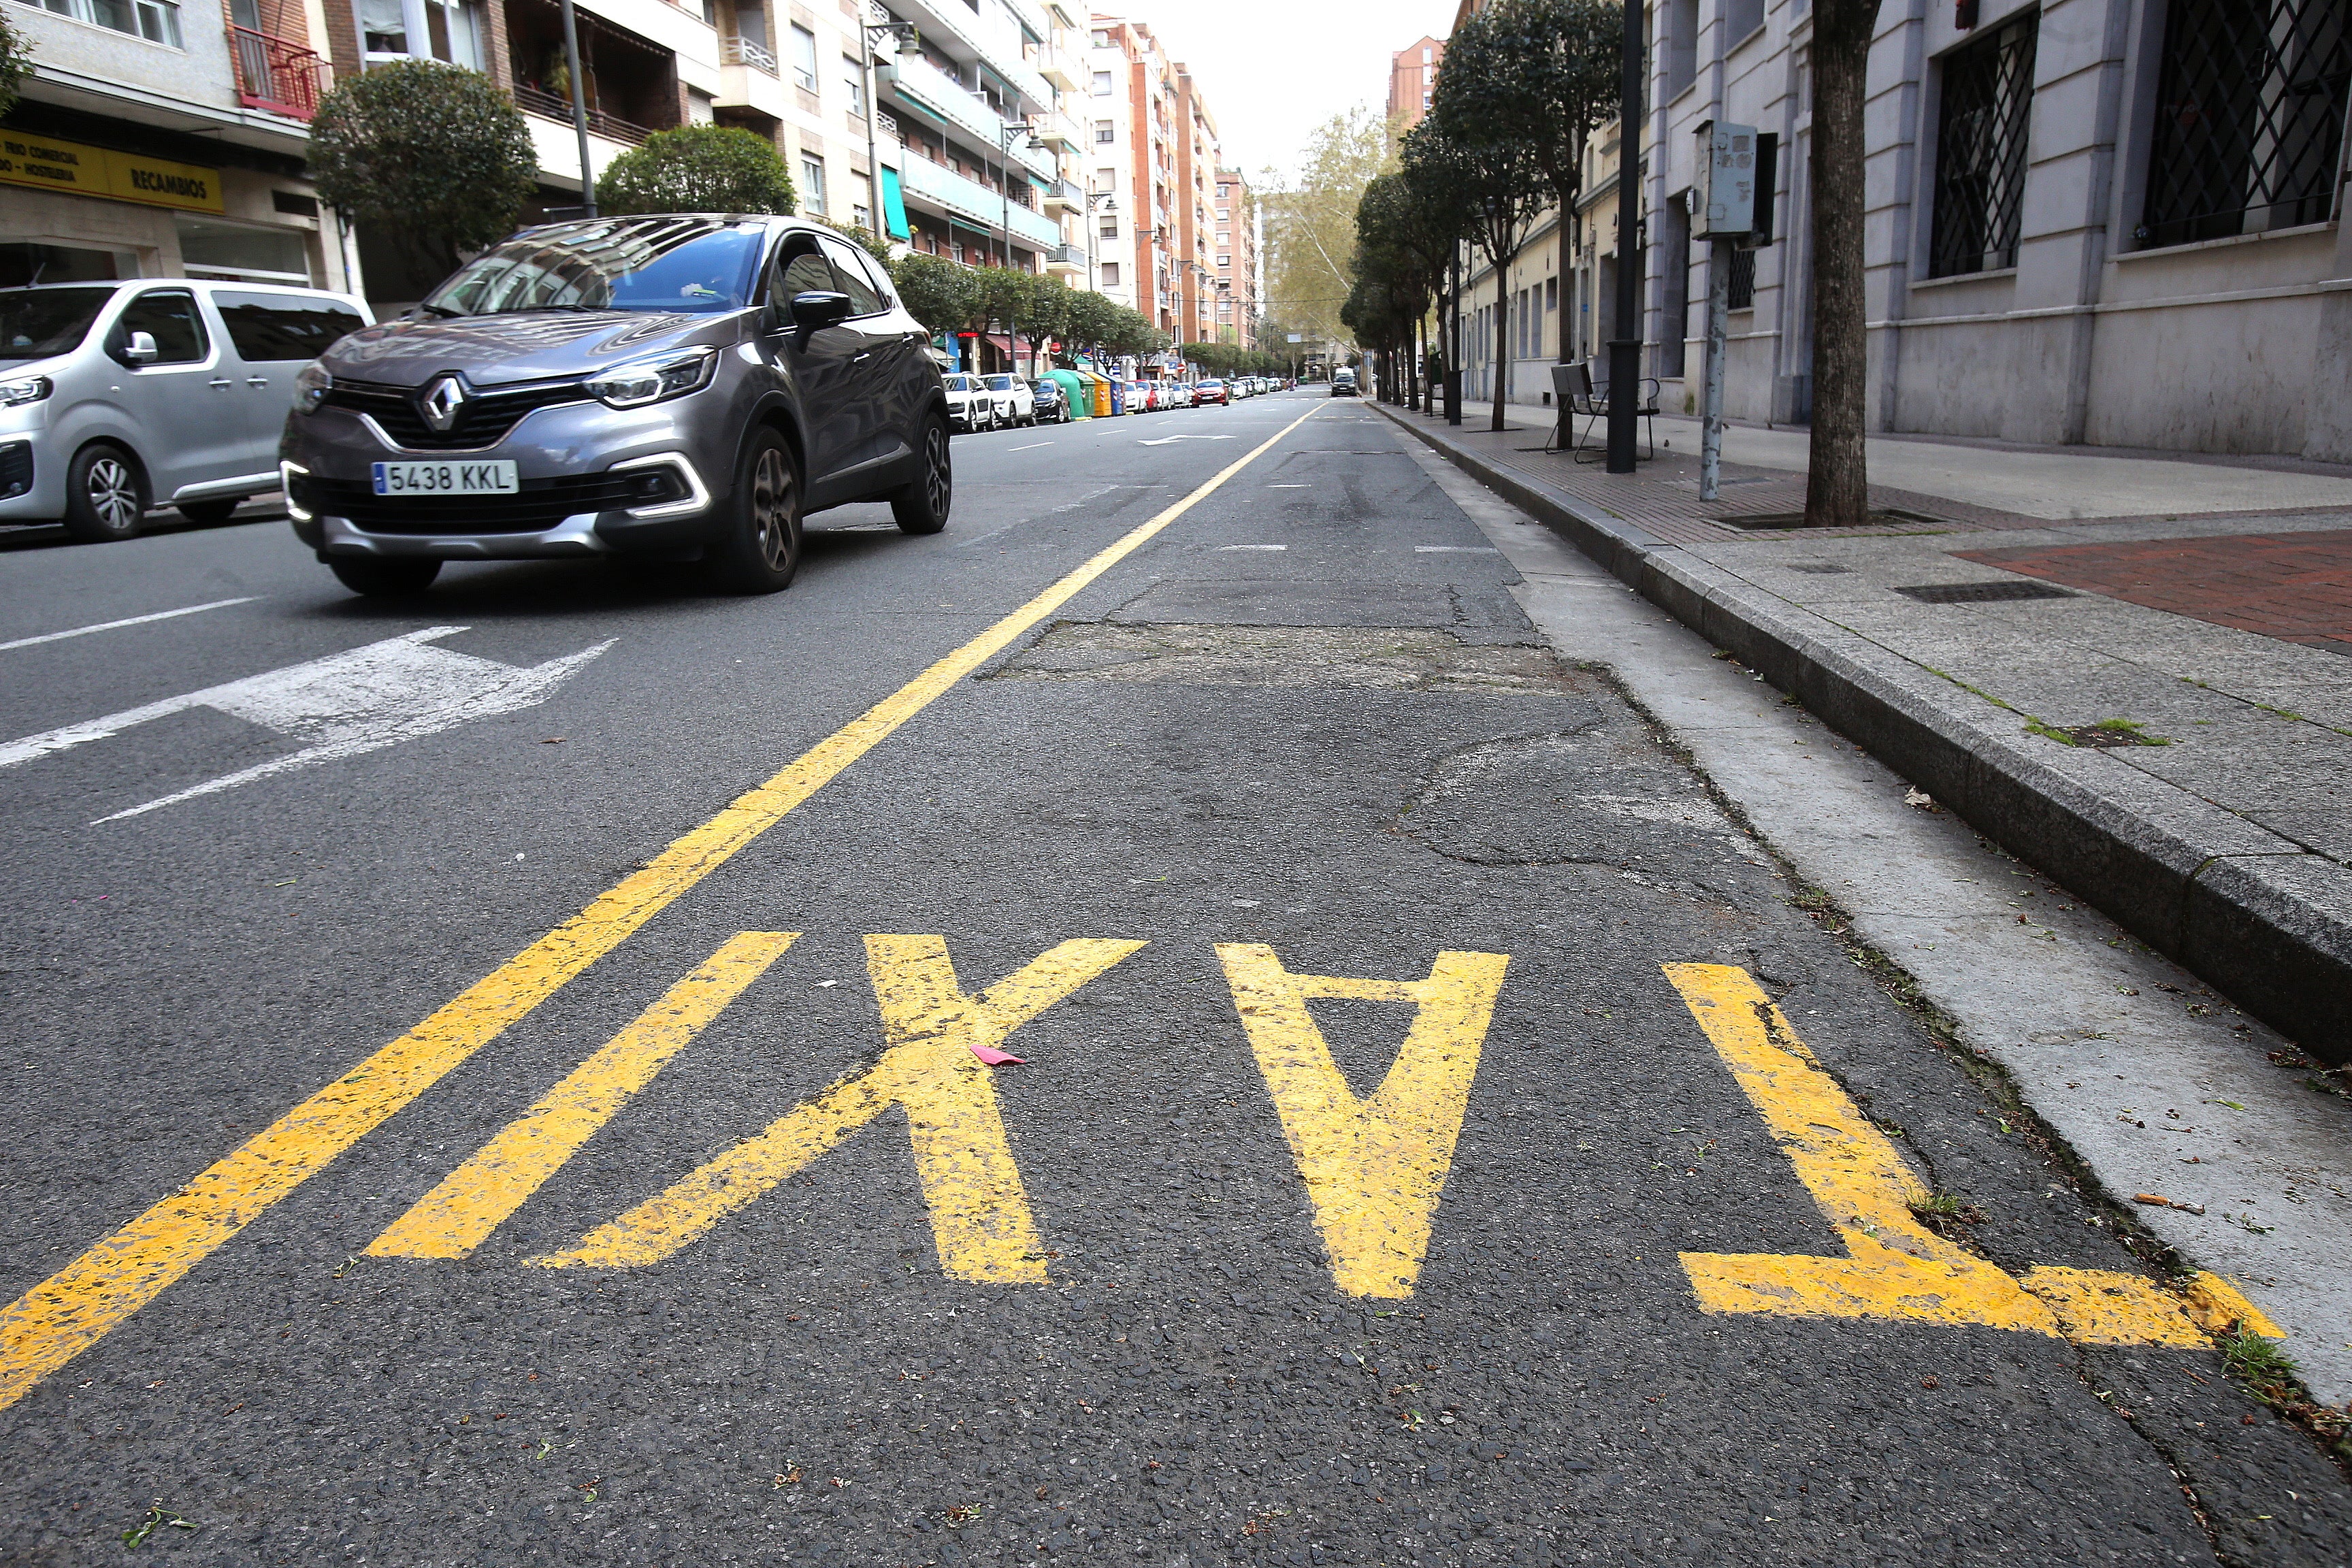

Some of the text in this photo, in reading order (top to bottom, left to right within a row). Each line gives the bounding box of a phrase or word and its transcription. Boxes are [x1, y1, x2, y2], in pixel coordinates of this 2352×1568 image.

[29, 146, 80, 165] COMERCIAL
[131, 169, 207, 199] RECAMBIOS
[390, 465, 510, 490] 5438 KKL
[360, 930, 2287, 1349] TAXI
